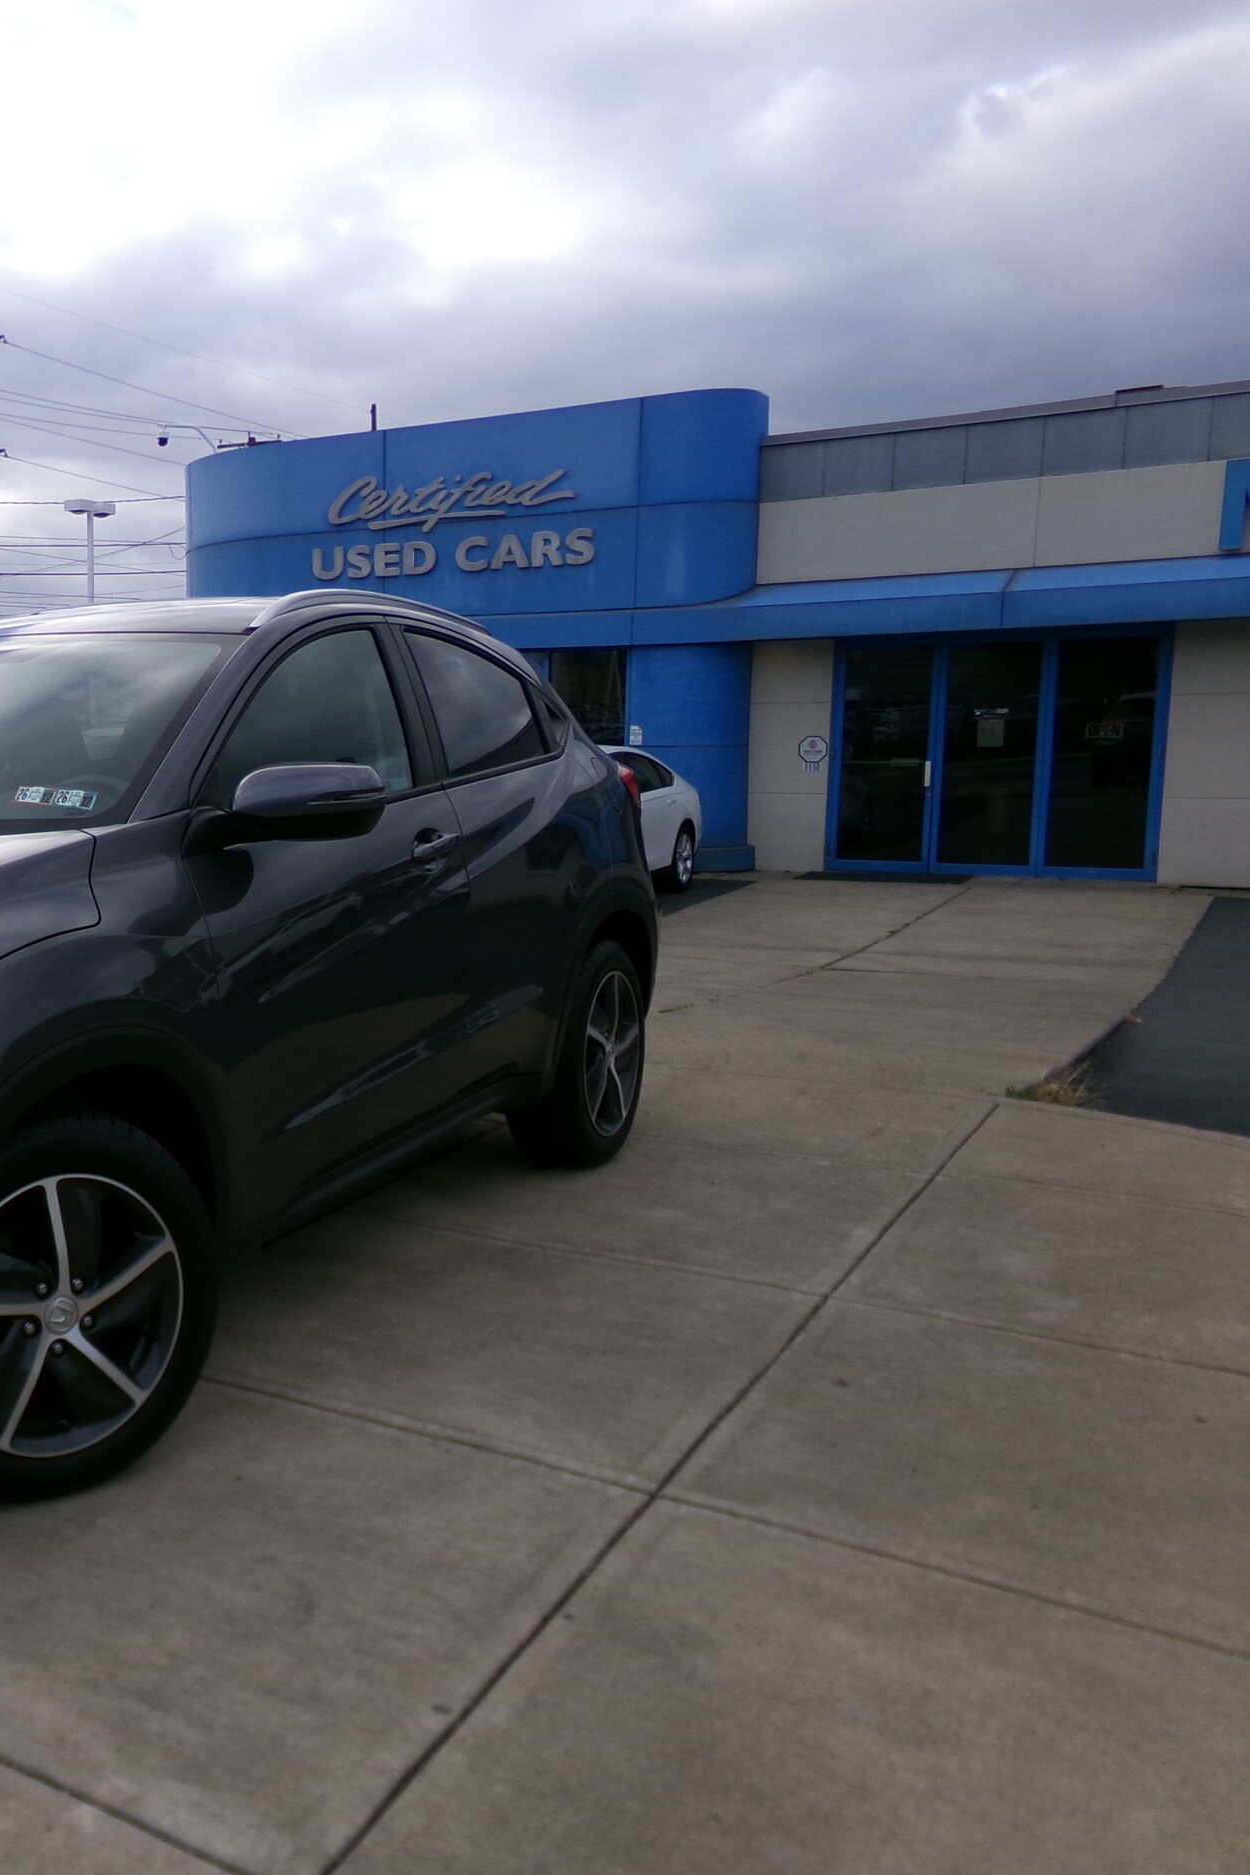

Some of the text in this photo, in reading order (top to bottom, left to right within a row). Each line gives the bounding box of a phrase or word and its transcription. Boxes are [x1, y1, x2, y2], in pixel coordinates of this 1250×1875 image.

[327, 469, 576, 533] Certified
[312, 527, 596, 580] USED CARS
[1087, 723, 1121, 737] OPEN
[16, 788, 30, 801] 26
[41, 792, 54, 804] 12
[56, 790, 70, 804] 26
[80, 795, 94, 808] 12
